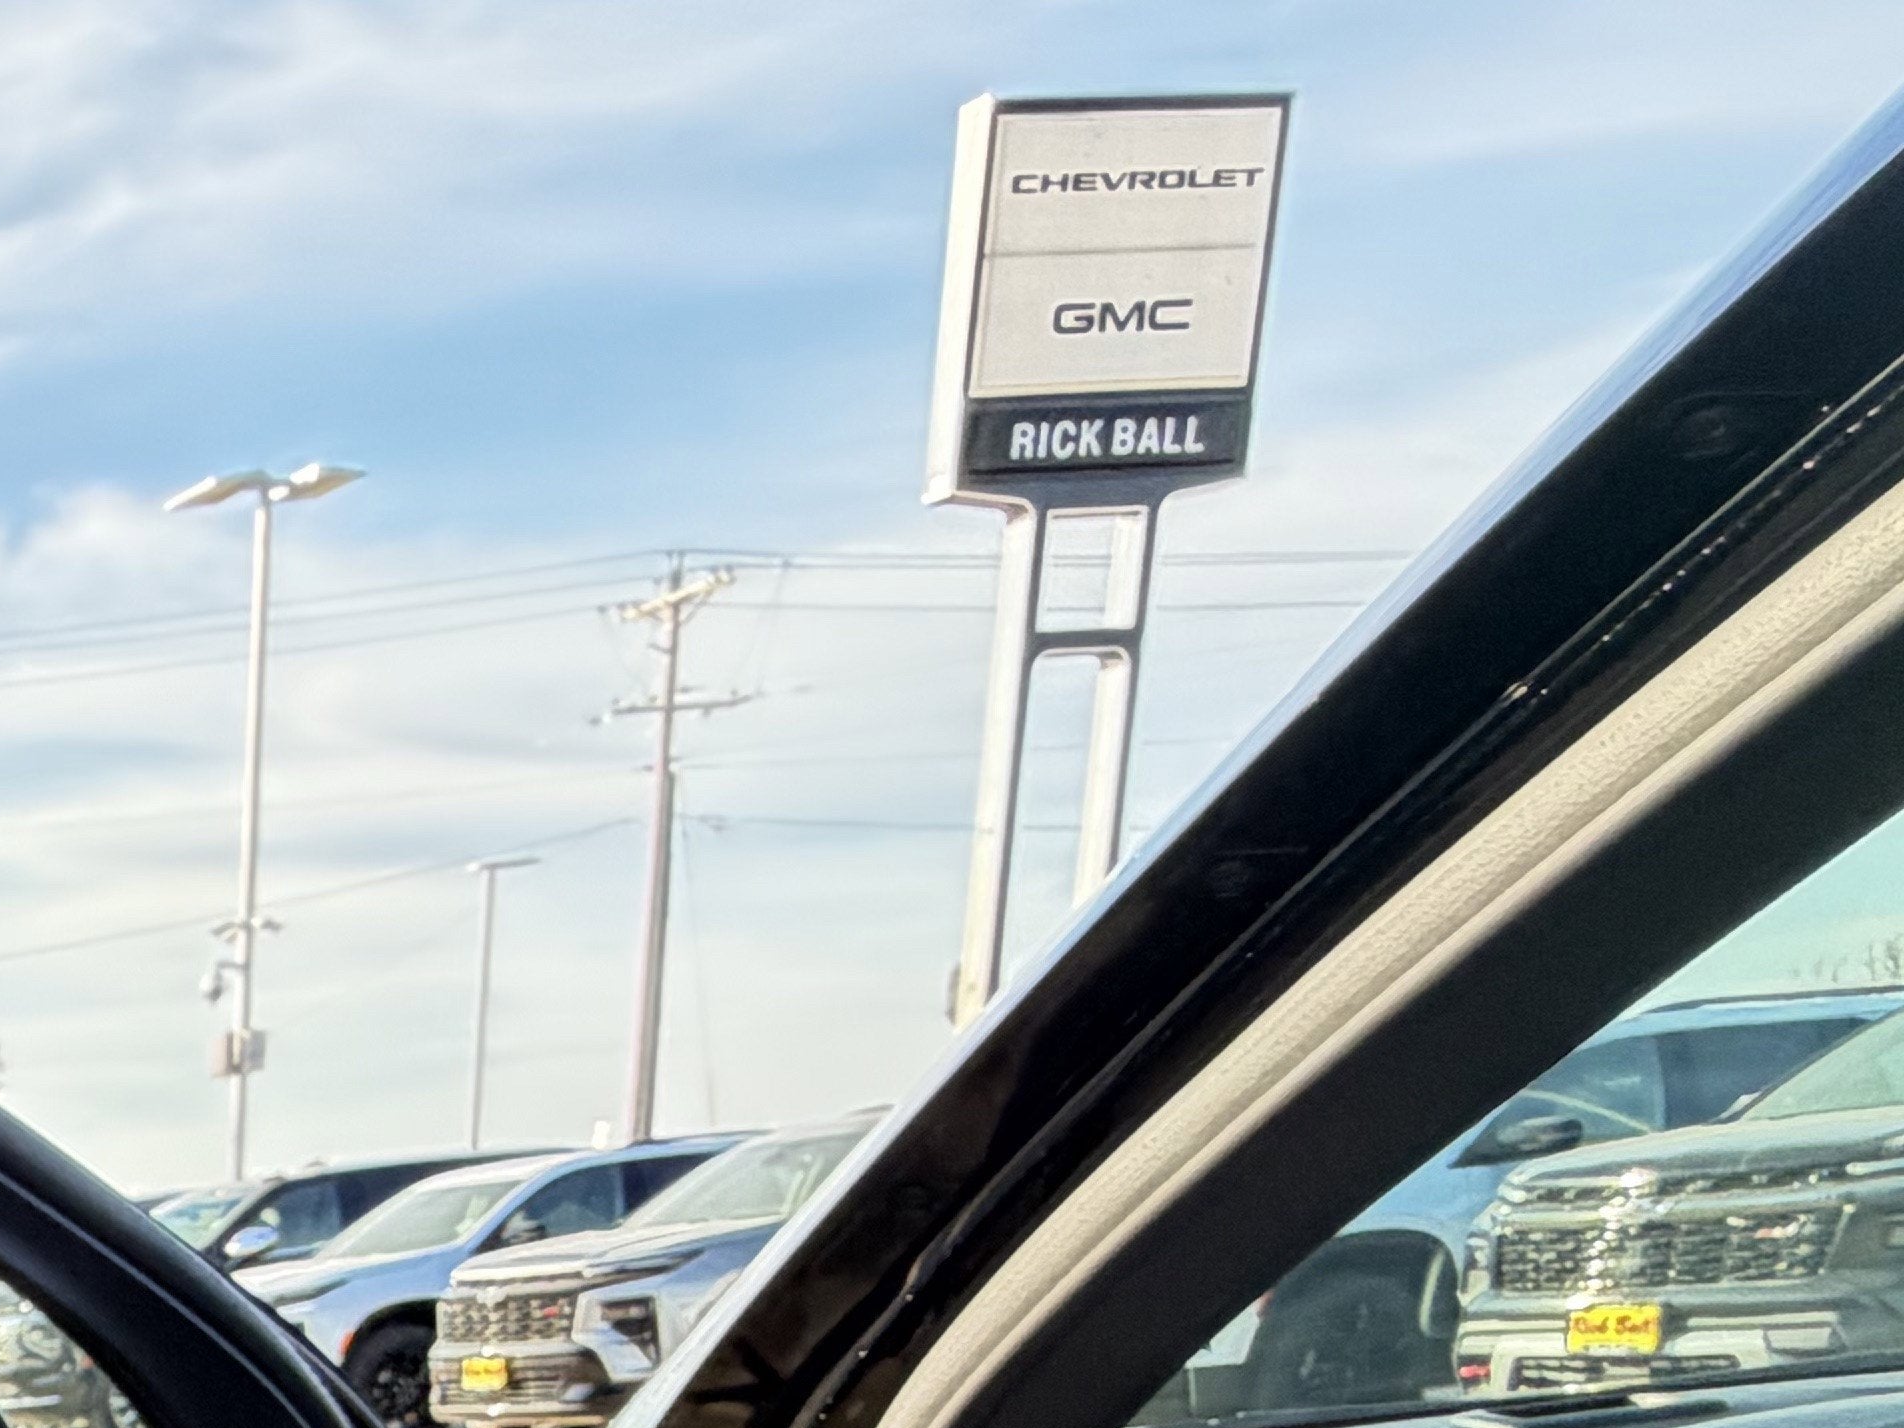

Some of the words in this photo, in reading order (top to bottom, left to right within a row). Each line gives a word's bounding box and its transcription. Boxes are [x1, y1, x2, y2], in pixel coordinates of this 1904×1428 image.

[1010, 166, 1265, 195] CHEVROLET
[1052, 298, 1194, 335] GMC
[1009, 417, 1104, 461] RICK
[1109, 414, 1206, 456] BALL
